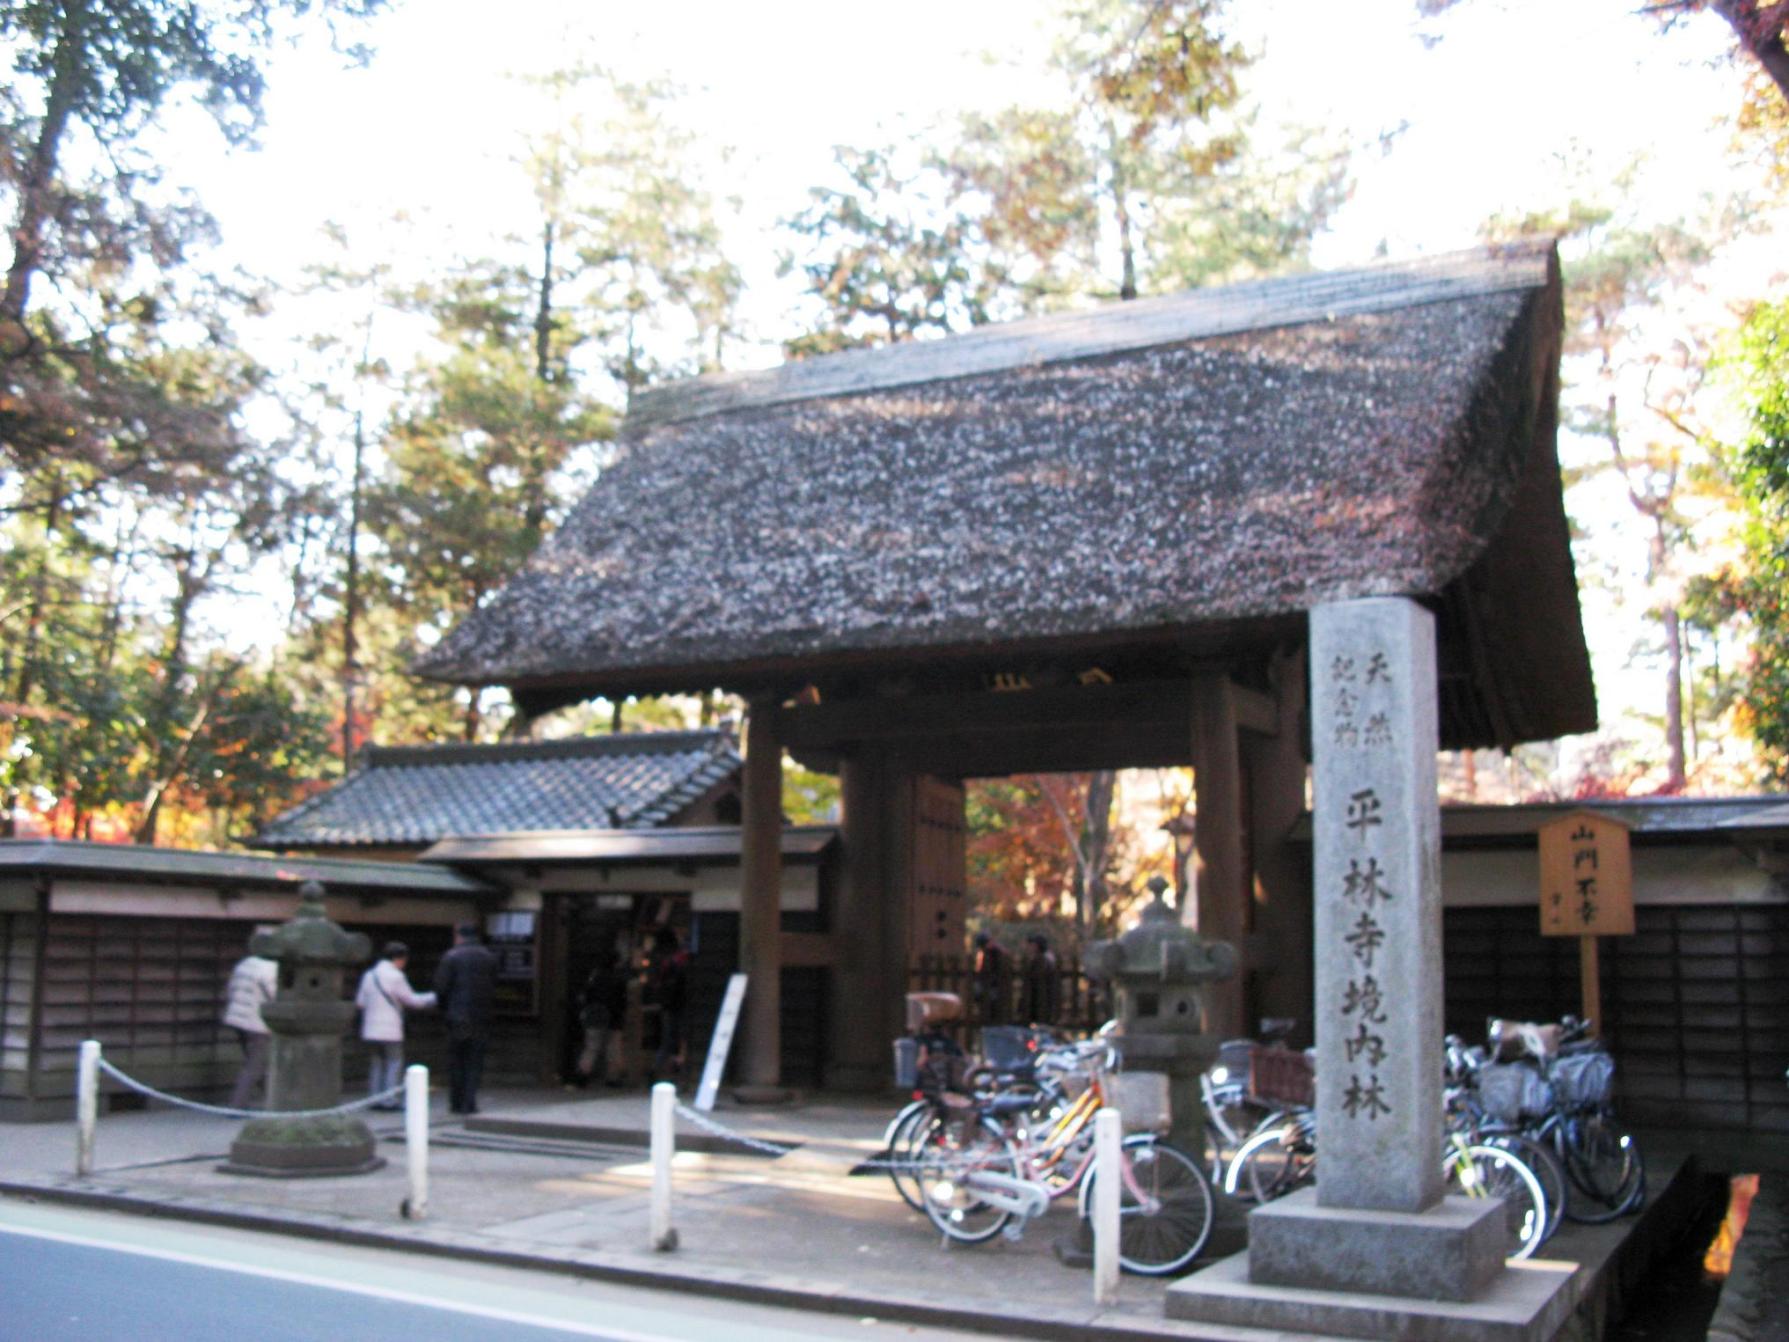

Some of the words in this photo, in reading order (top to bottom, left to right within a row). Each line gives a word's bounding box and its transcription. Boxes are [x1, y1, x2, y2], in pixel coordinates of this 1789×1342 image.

[1329, 654, 1359, 749] 記念物
[1364, 651, 1394, 747] 天然
[1341, 788, 1394, 1121] 平林寺境内林
